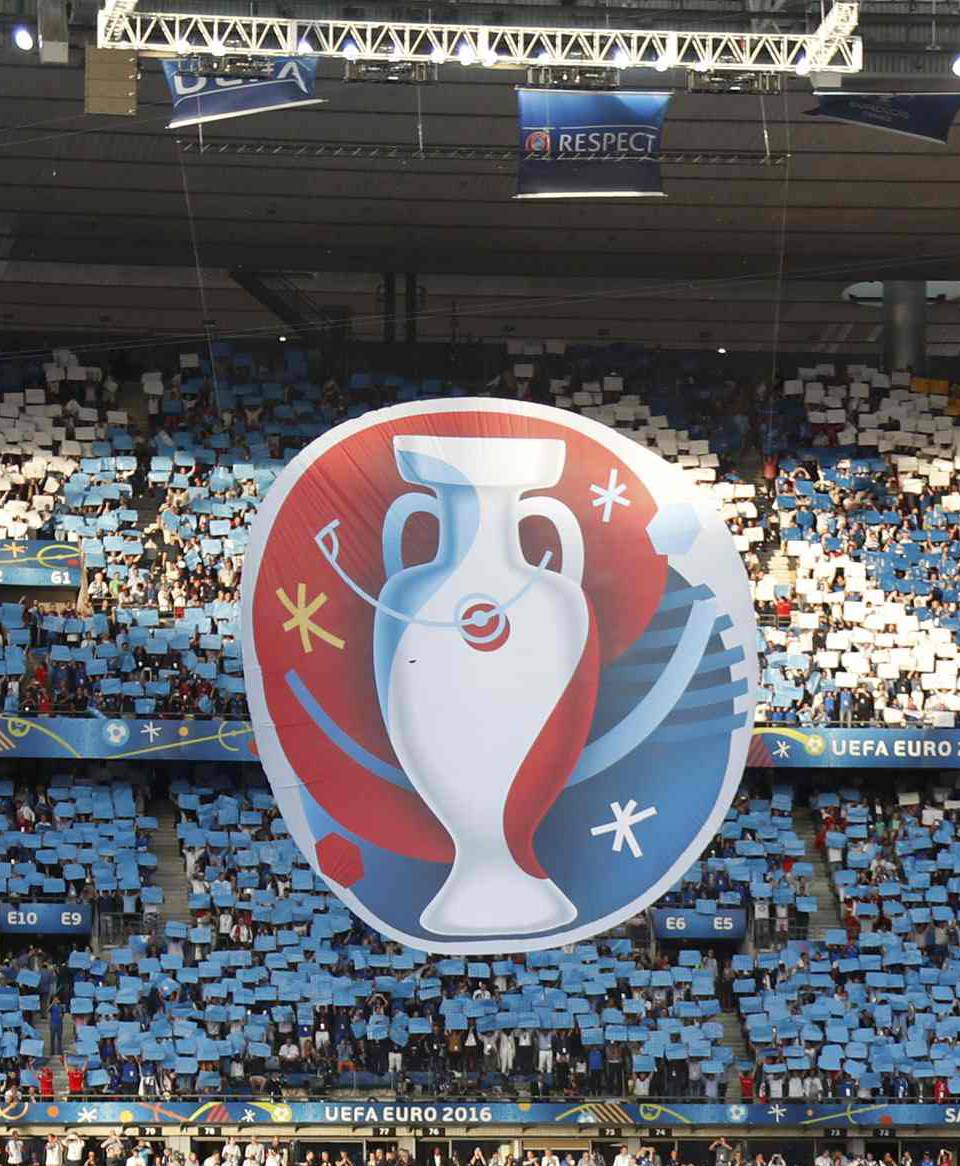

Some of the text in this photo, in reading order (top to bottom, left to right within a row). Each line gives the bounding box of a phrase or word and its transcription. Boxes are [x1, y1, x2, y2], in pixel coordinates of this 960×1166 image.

[173, 61, 310, 96] UA
[559, 132, 656, 153] RESPECT
[831, 740, 889, 756] UEFA
[894, 740, 951, 757] EURO
[7, 912, 82, 926] E10 E9
[666, 917, 733, 930] E6 E5
[325, 1107, 492, 1121] UEFA EURO 2016
